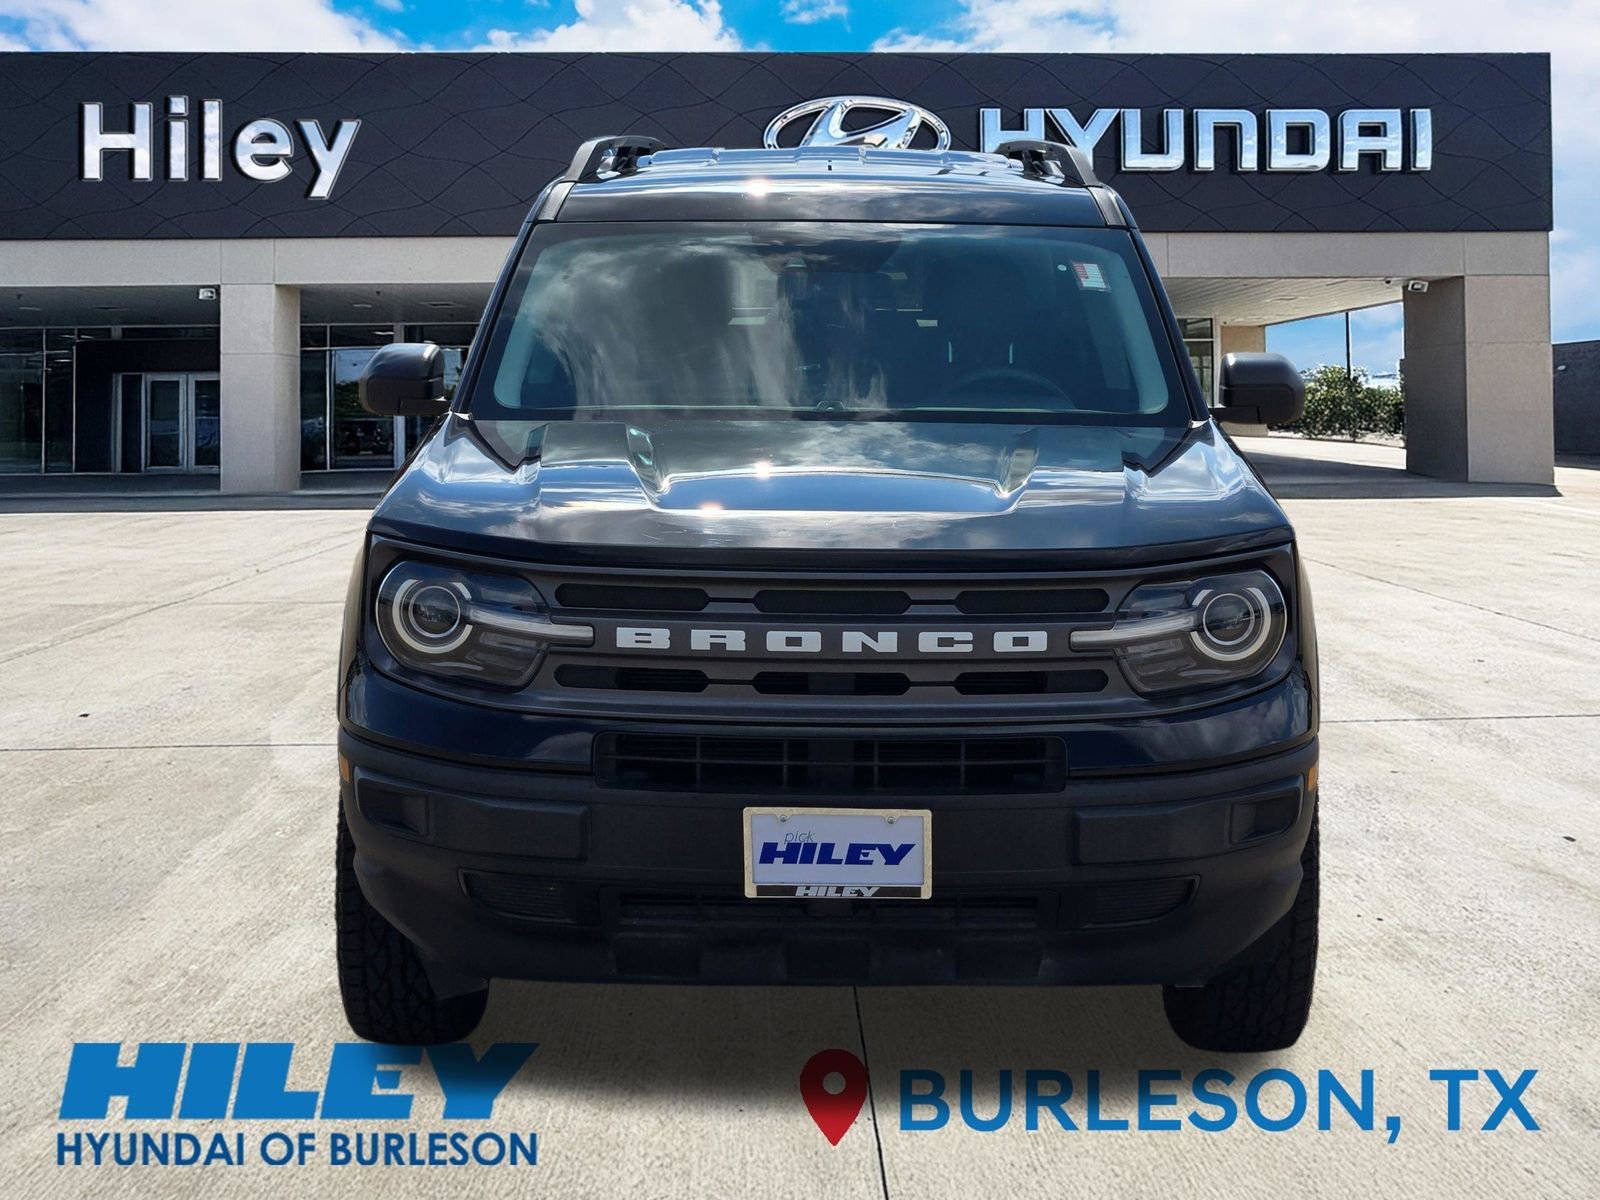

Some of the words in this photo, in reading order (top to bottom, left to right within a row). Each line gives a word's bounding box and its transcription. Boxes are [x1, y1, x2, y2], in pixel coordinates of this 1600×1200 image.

[79, 95, 361, 200] Hiley
[980, 107, 1433, 173] HYUNDAI
[615, 626, 1048, 653] BRONCO
[784, 830, 816, 844] pick
[758, 842, 916, 866] HILEY
[795, 886, 881, 897] HILEY
